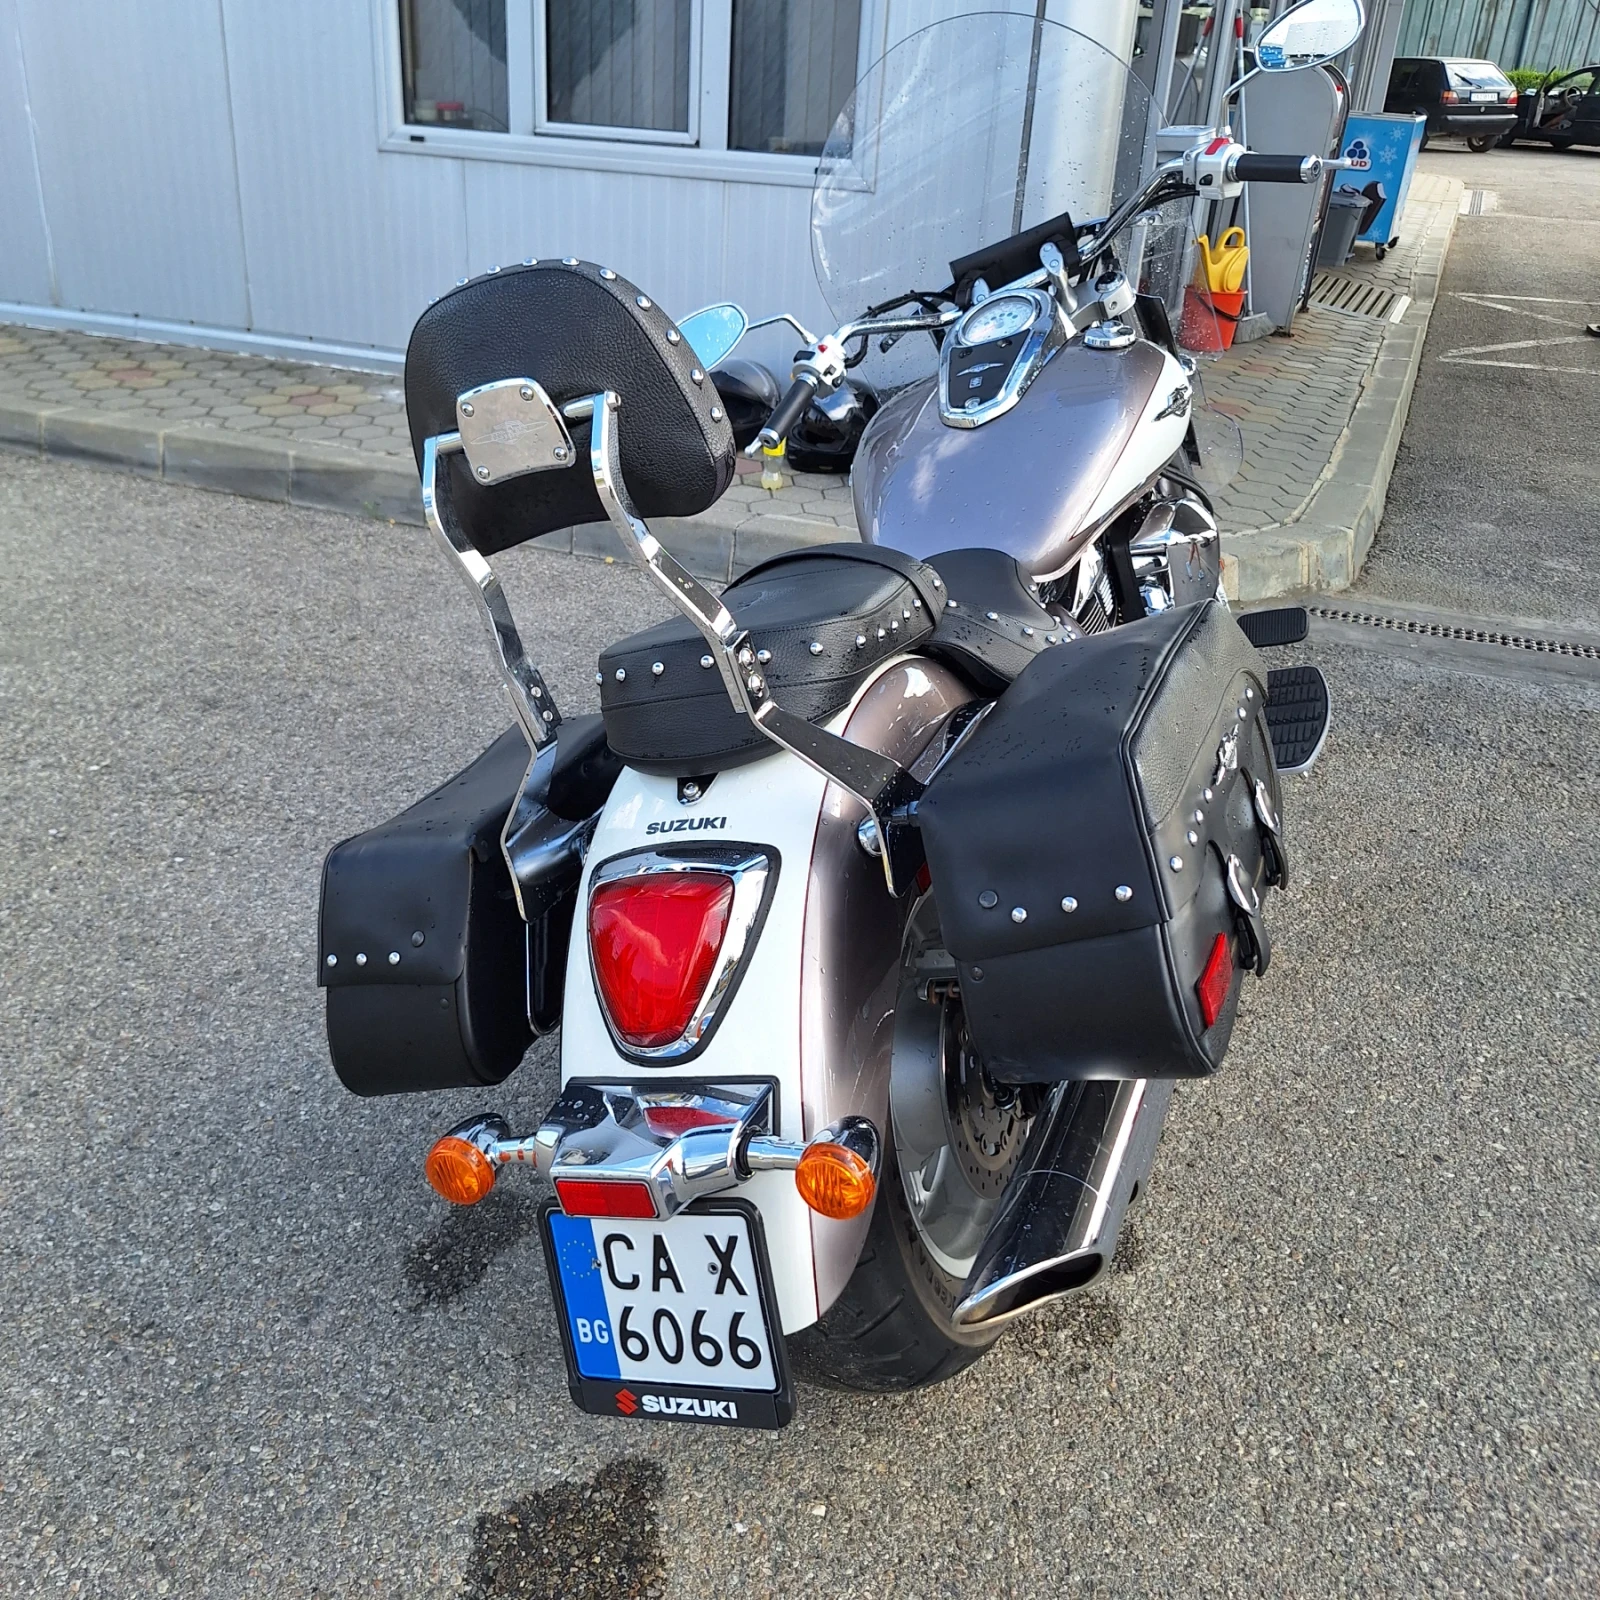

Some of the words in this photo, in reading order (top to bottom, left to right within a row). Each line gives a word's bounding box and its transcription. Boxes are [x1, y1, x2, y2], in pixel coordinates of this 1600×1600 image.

[645, 816, 728, 836] SUZUKI
[602, 1232, 686, 1294] CA
[703, 1234, 749, 1297] X
[576, 1317, 609, 1345] BG
[618, 1305, 763, 1370] 6066
[641, 1394, 739, 1420] SUZUKI
